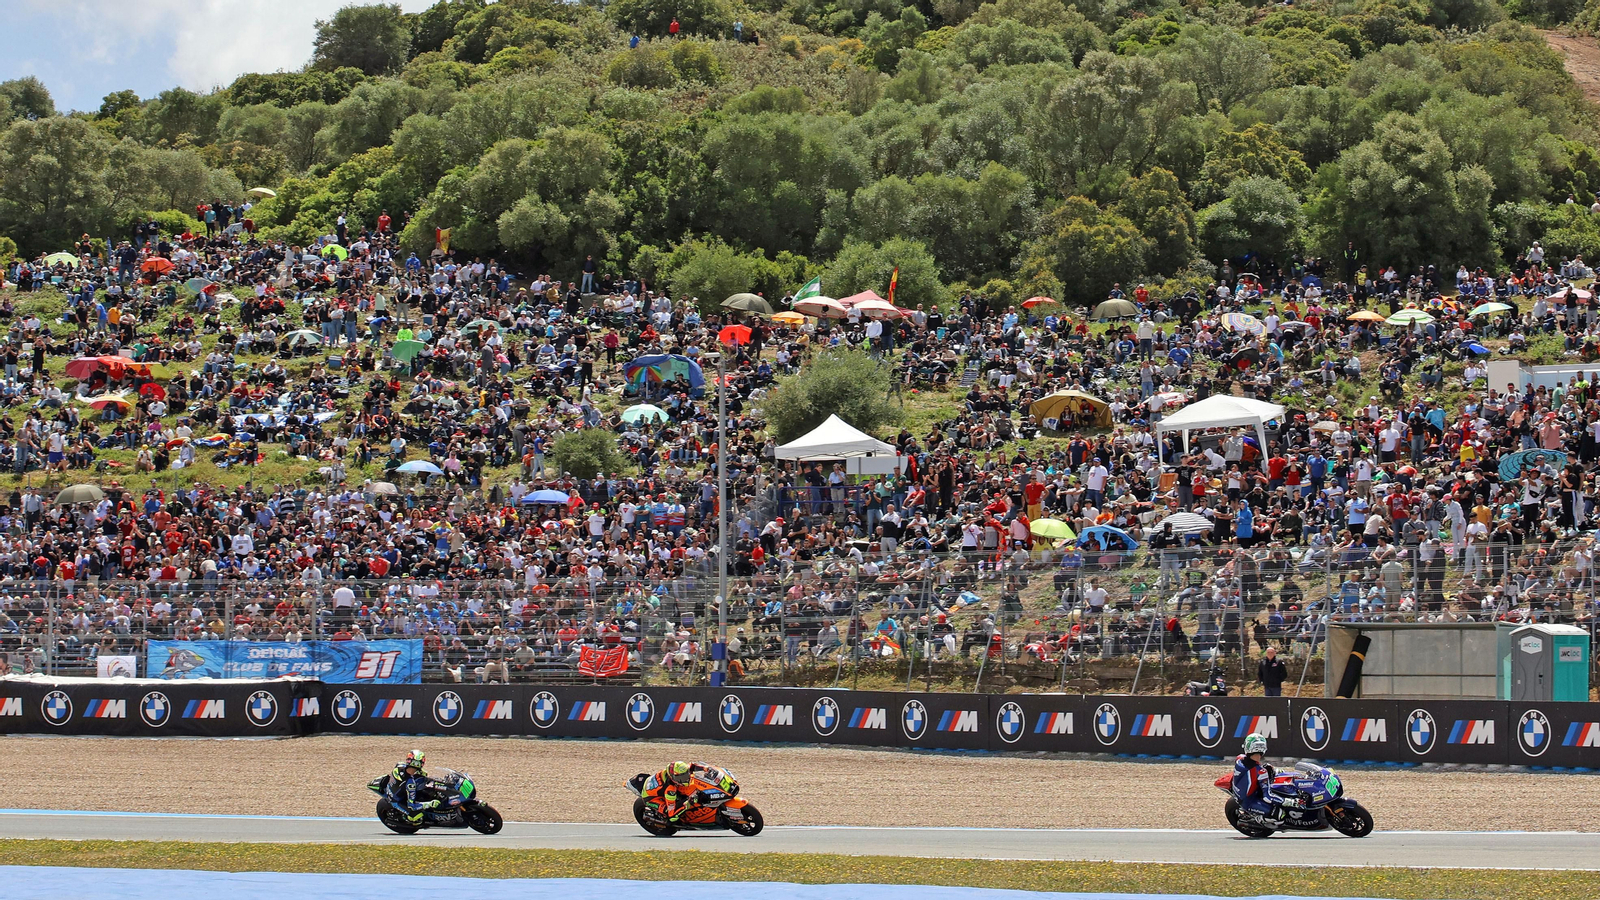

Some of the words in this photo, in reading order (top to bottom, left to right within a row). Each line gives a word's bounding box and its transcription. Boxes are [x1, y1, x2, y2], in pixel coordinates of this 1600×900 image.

[222, 662, 264, 672] CLUB
[267, 662, 289, 672] DE
[291, 662, 333, 672] FANS
[355, 651, 401, 679] 31
[46, 693, 68, 702] BMW
[145, 694, 166, 703] BMW
[251, 693, 273, 703] BMW
[337, 692, 357, 702] BMW
[438, 693, 459, 703] BMW
[535, 694, 555, 704] BMW
[631, 695, 650, 705] BMW
[723, 697, 741, 707] BMW
[0, 698, 22, 716] M
[102, 700, 125, 718] M
[201, 700, 224, 718] M
[301, 697, 319, 716] M
[389, 700, 412, 718] M
[490, 700, 512, 719] M
[817, 699, 836, 710] BMW
[906, 702, 924, 713] BMW
[1001, 705, 1021, 716] BMW
[584, 702, 605, 721] M
[679, 702, 701, 722] M
[770, 705, 792, 725] M
[1098, 706, 1117, 717] BMW
[1199, 708, 1220, 719] BMW
[1306, 710, 1326, 721] BMW
[864, 708, 886, 729] M
[954, 711, 977, 732] M
[1052, 713, 1073, 734] M
[1411, 712, 1432, 724] BMW
[1523, 713, 1546, 725] BMW
[1148, 715, 1172, 736] M
[1252, 716, 1278, 739] M
[1361, 719, 1386, 742] M
[1468, 720, 1494, 744] M
[1583, 723, 1600, 747] M
[687, 807, 713, 819] Beta
[1285, 817, 1319, 826] nlyFans
